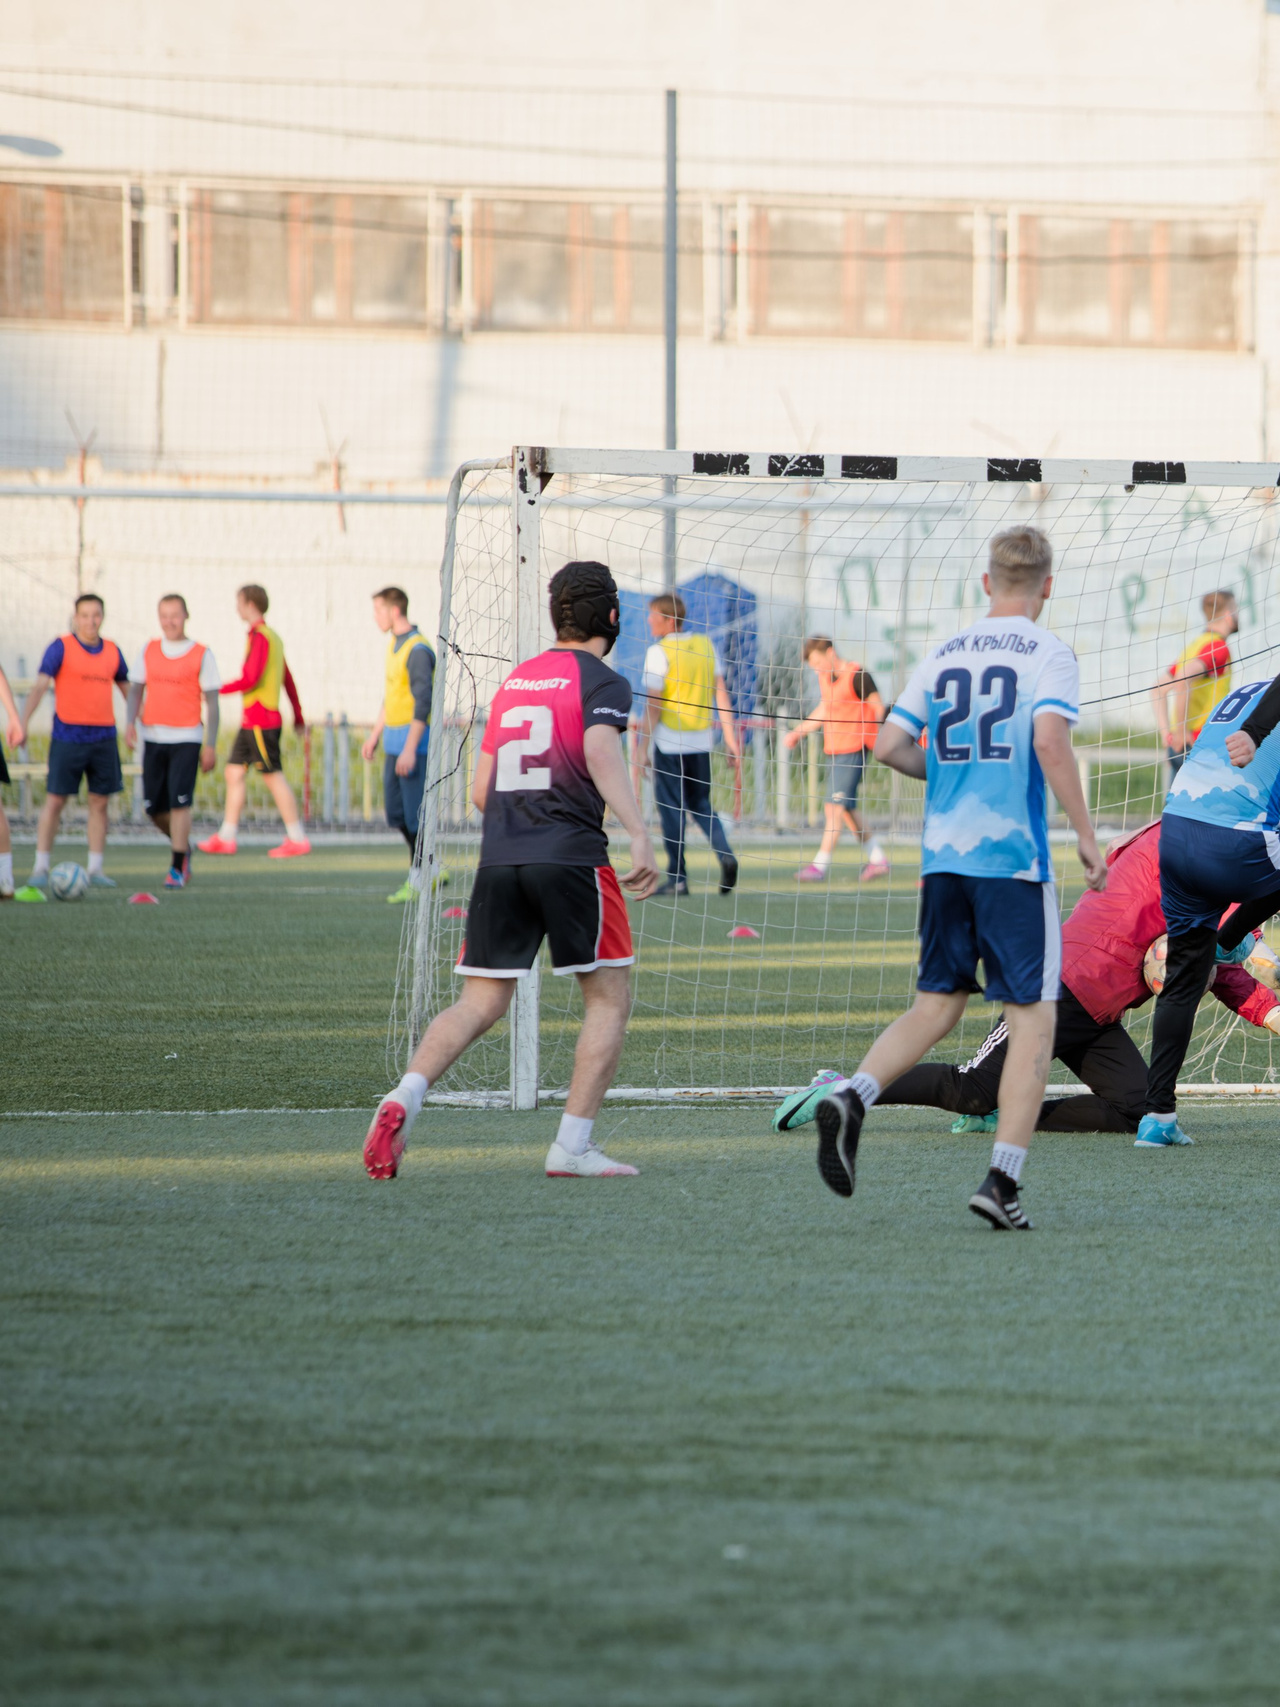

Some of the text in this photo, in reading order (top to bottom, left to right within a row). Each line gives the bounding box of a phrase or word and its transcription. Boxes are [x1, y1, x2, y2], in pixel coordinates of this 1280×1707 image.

[971, 633, 1039, 656] КРЫЛЬЯ
[933, 665, 1018, 763] 22
[1209, 679, 1272, 724] 8
[495, 705, 553, 791] 2
